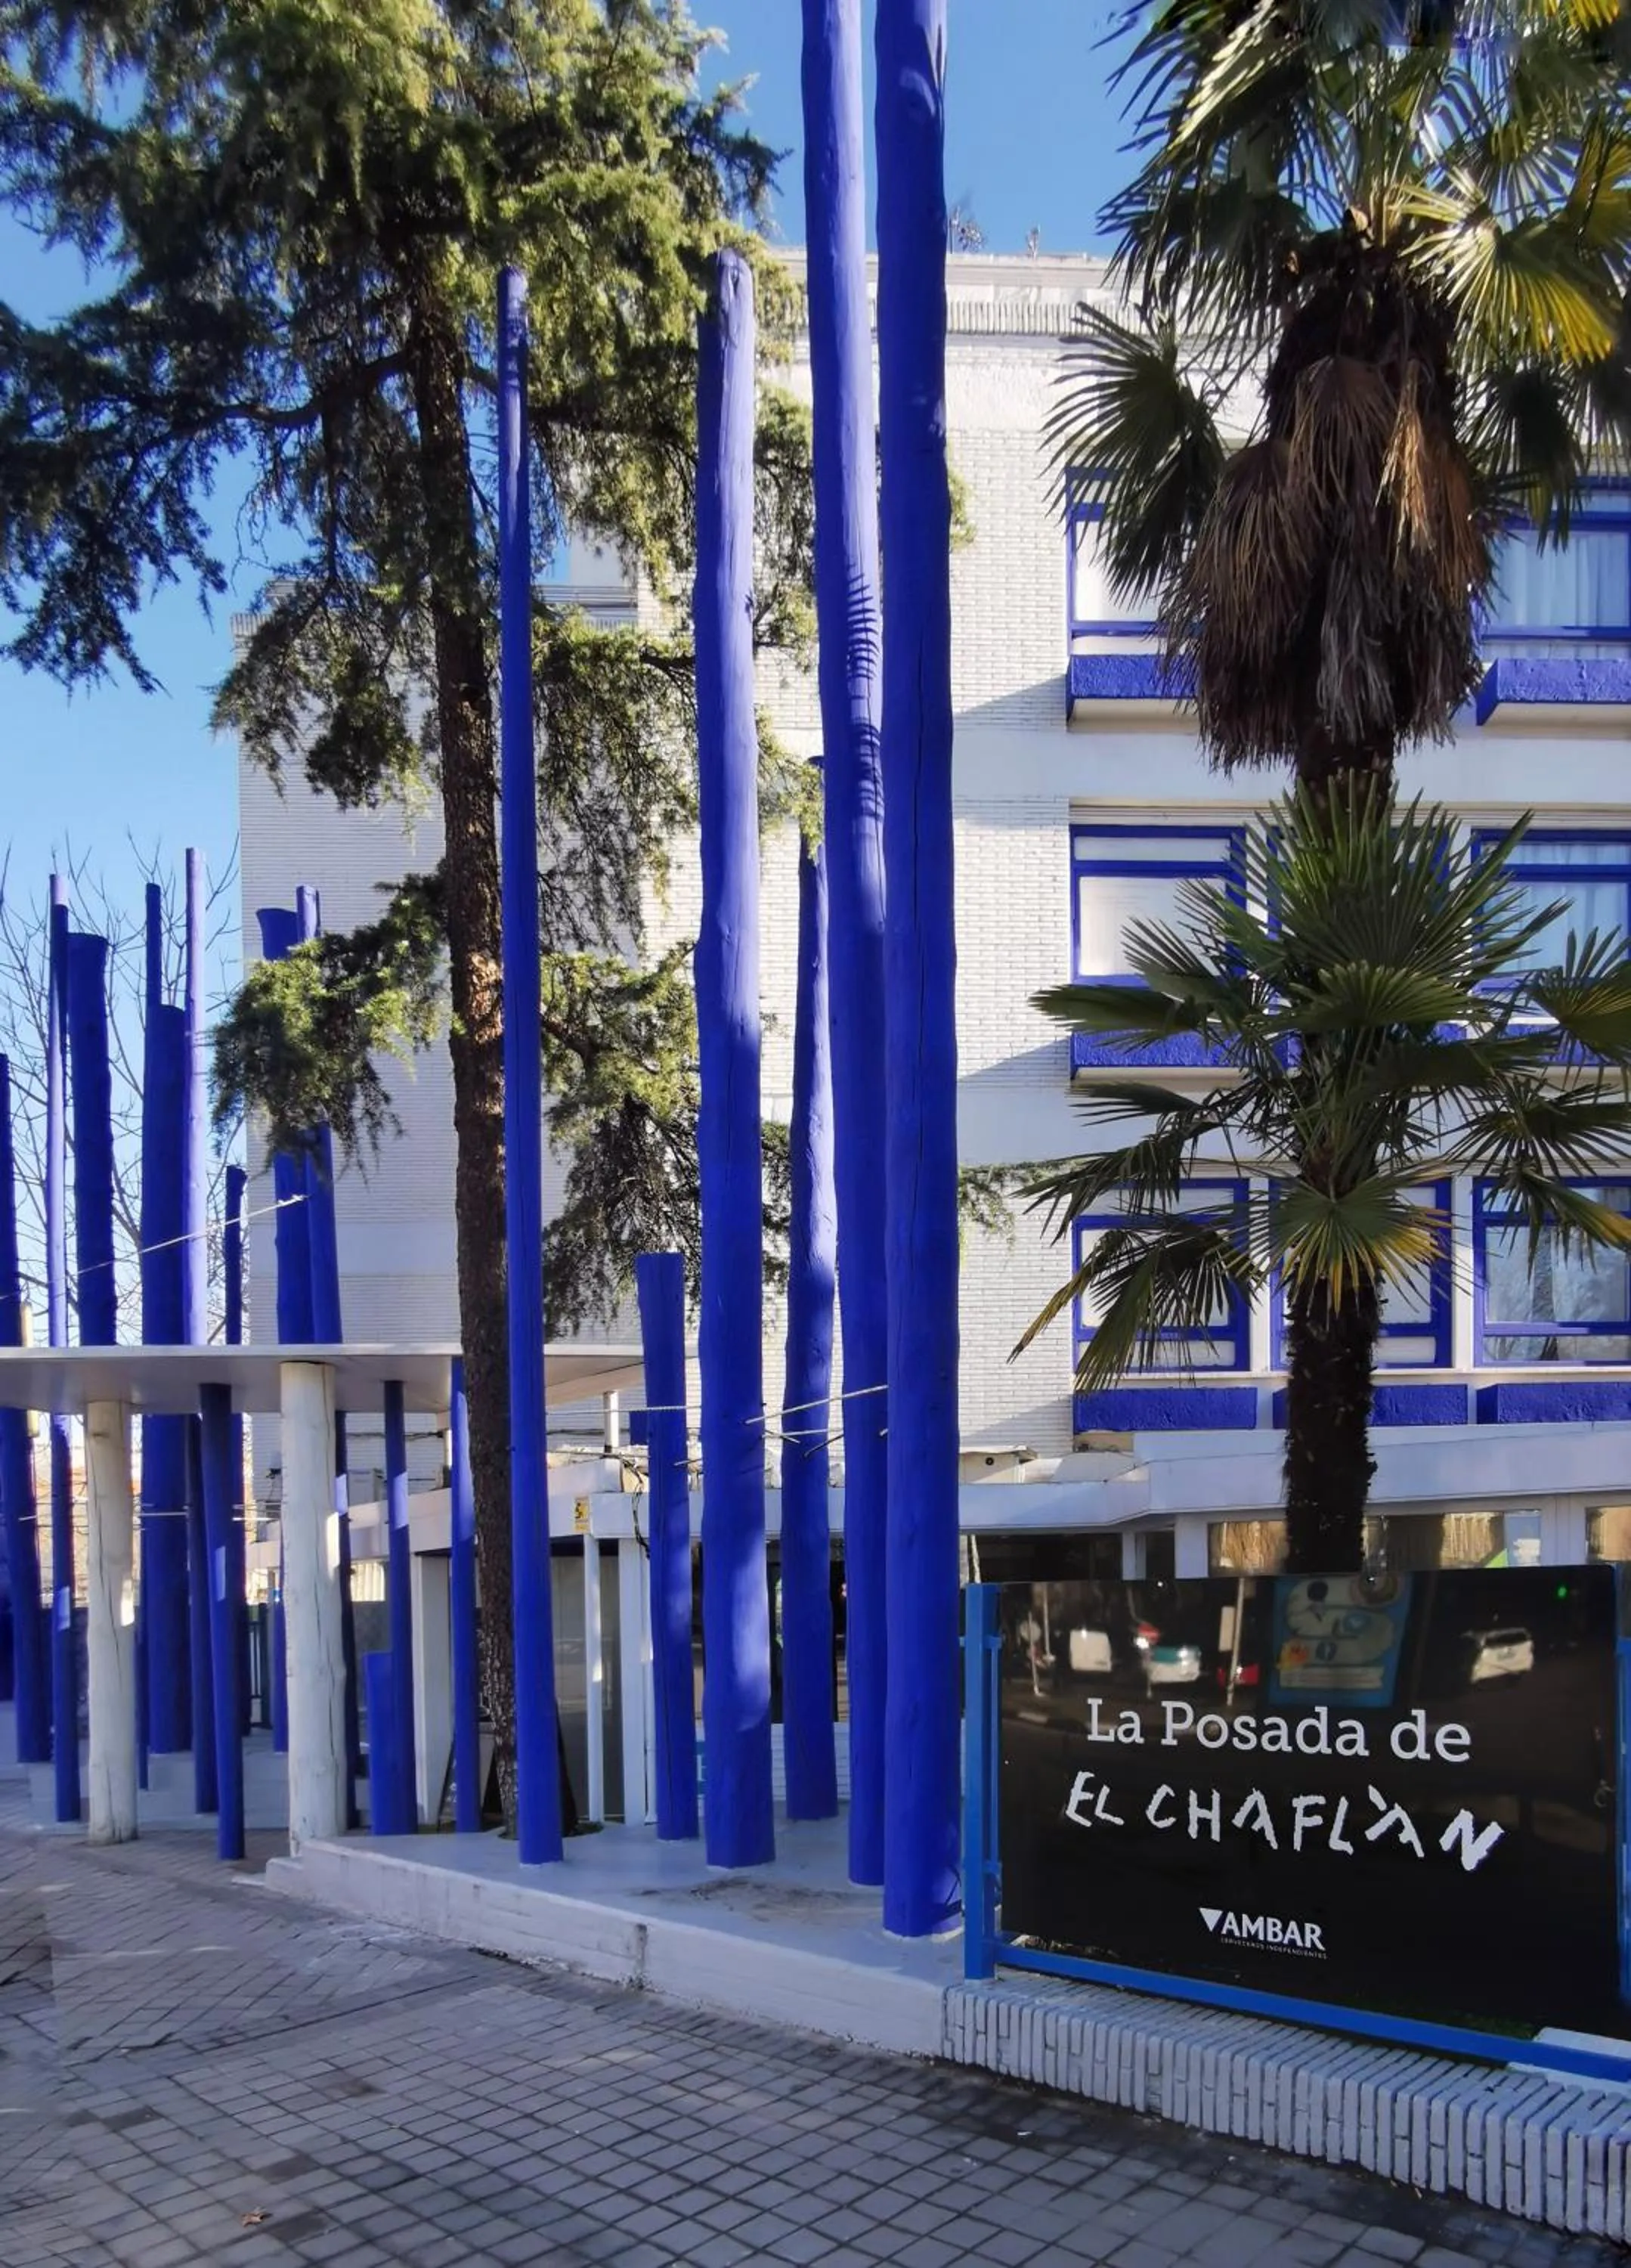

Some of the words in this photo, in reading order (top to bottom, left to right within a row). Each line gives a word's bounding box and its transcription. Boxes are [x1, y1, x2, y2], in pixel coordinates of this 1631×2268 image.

[1087, 1697, 1144, 1745] La
[1161, 1700, 1369, 1758] Posada
[1390, 1709, 1472, 1763] de
[1065, 1771, 1125, 1827] EL
[1221, 1910, 1326, 1951] AMBAR
